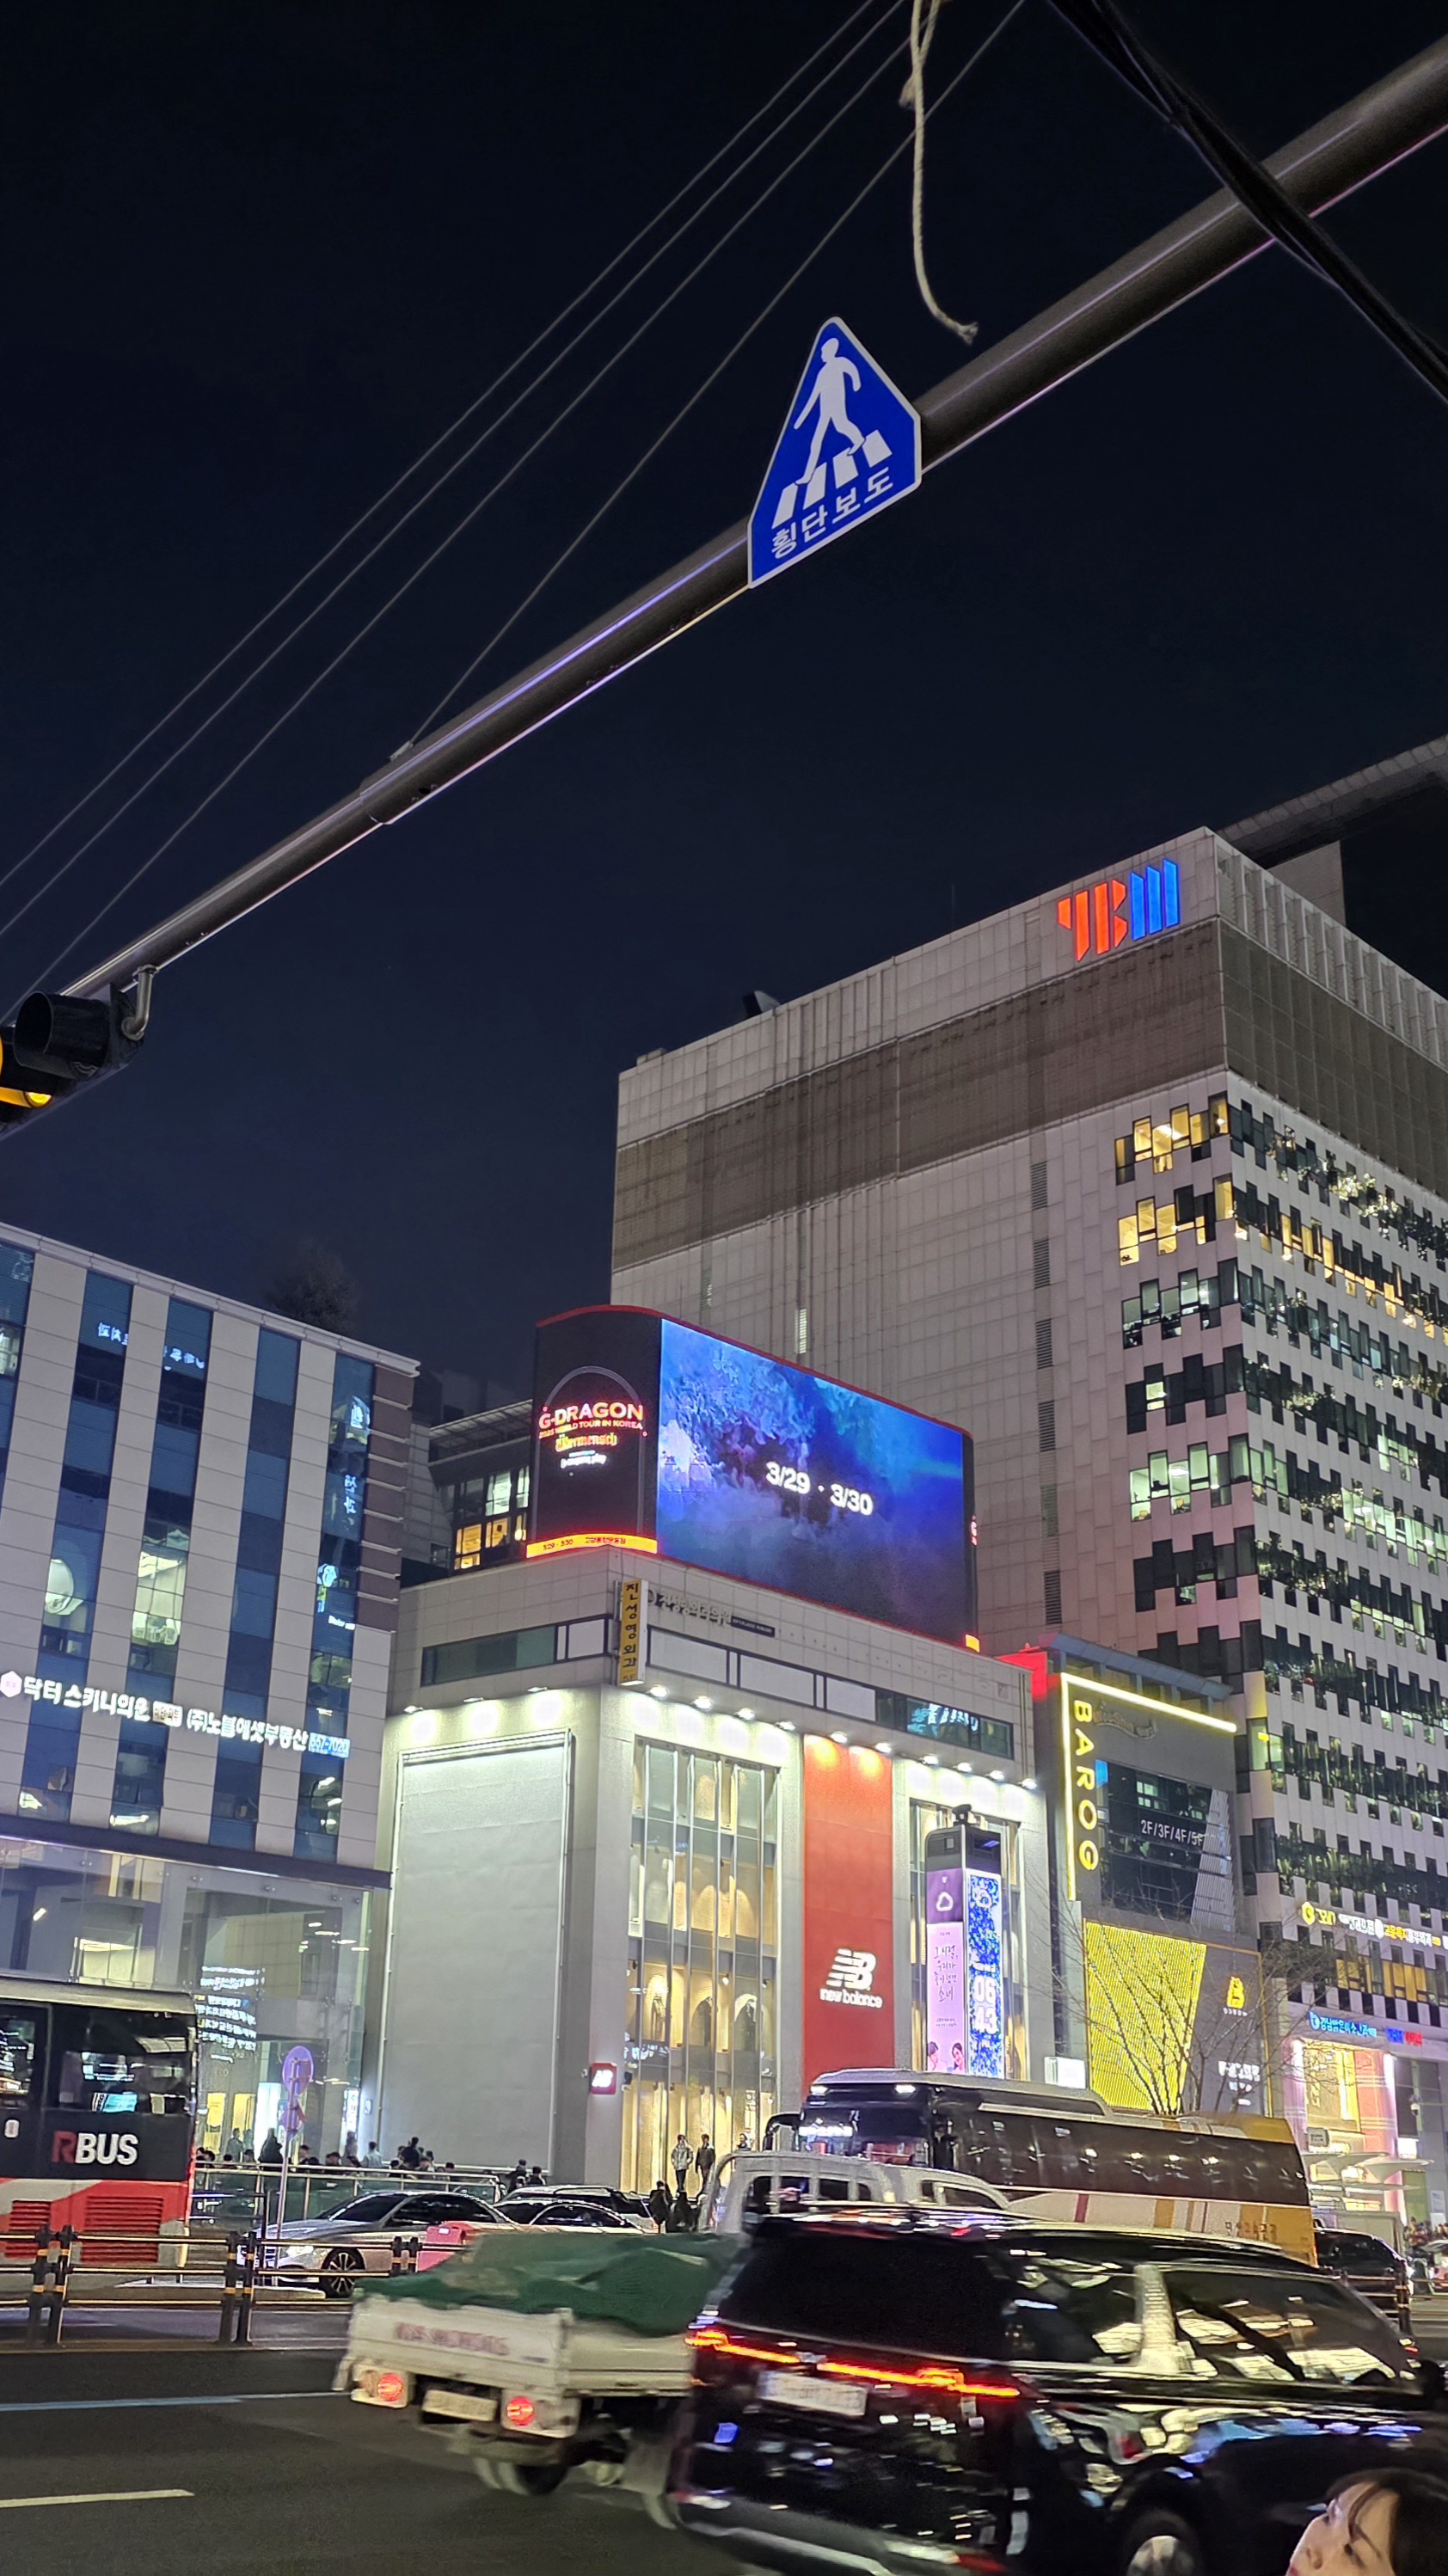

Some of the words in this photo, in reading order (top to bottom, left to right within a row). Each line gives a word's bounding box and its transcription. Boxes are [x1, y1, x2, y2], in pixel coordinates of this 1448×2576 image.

[771, 467, 893, 559] 횡단보도
[1058, 858, 1181, 962] YBM
[539, 1402, 643, 1429] G-DRAGON
[579, 1420, 600, 1428] TOUR
[613, 1420, 643, 1430] KOREA
[765, 1461, 811, 1494] 3/29
[830, 1483, 874, 1516] 3/30
[622, 1583, 640, 1668] 진성영외과
[23, 1676, 62, 1705] 닥터
[1074, 1699, 1100, 1871] BAROG
[1140, 1819, 1204, 1847] 2F/3F/4F/5F
[842, 1989, 884, 2009] balance
[52, 2131, 138, 2165] RBUS
